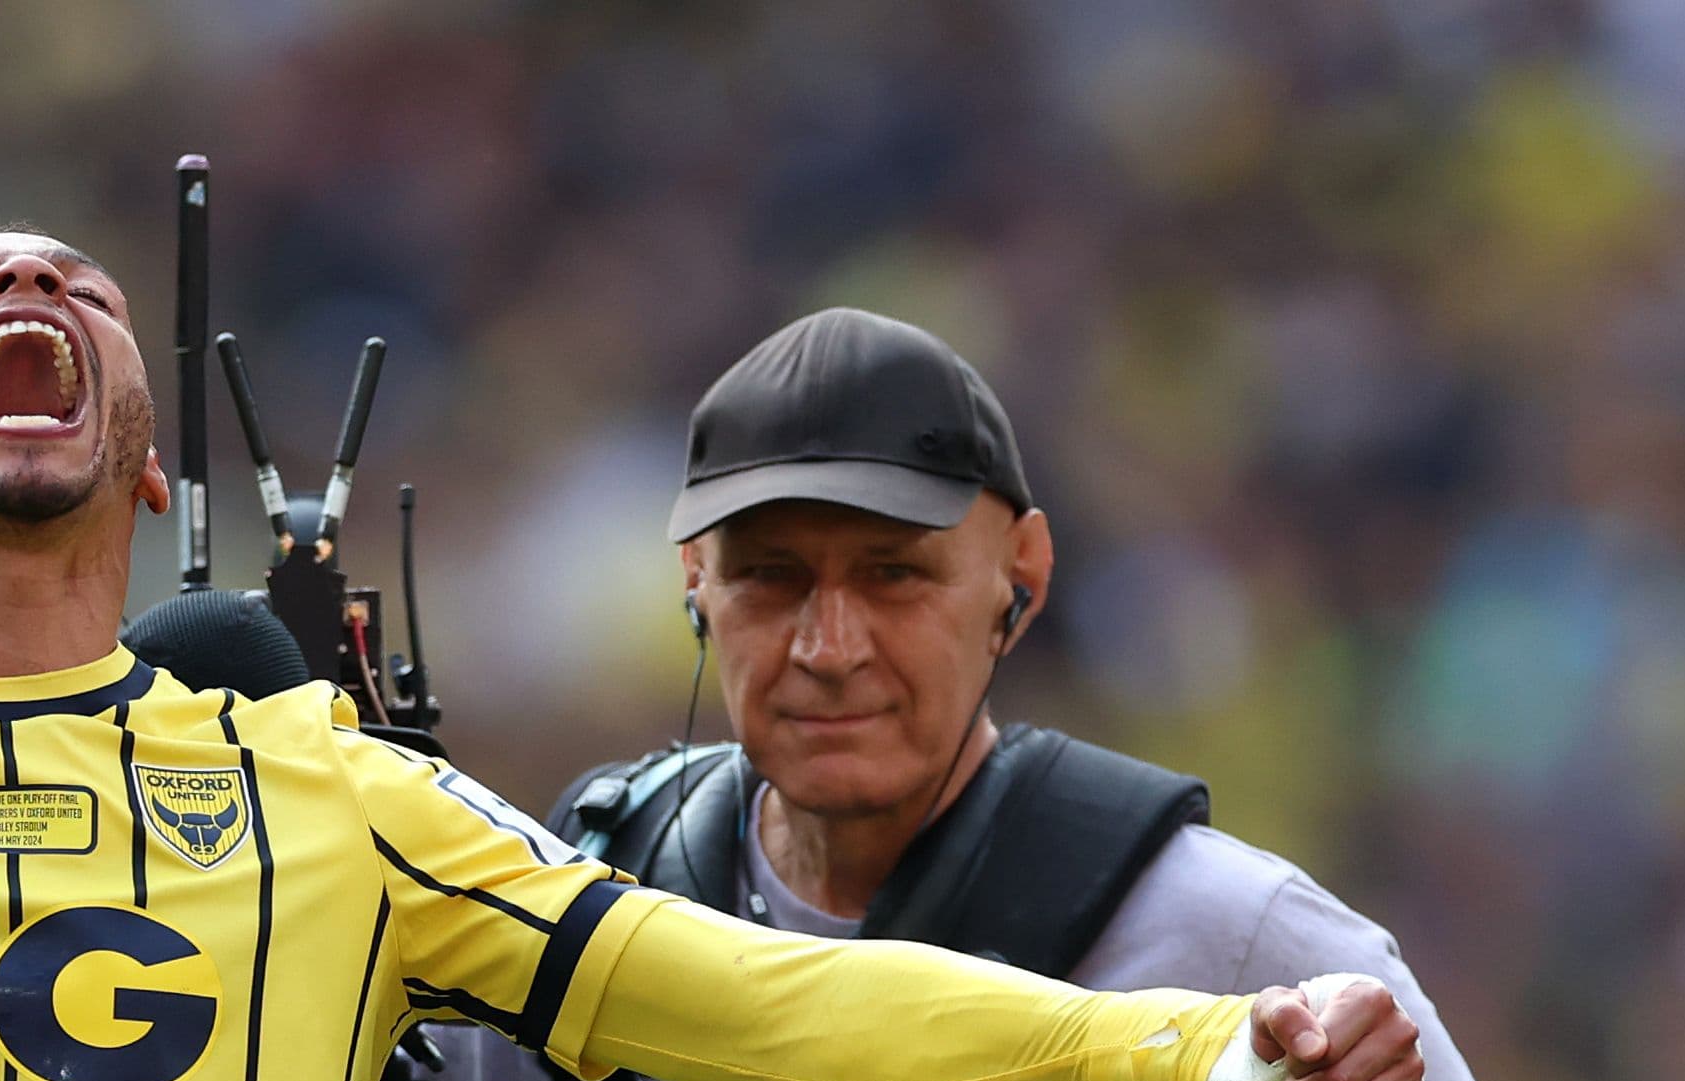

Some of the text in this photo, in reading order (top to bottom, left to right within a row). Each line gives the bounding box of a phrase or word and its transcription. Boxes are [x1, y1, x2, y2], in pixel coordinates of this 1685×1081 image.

[146, 774, 232, 791] OXFORD
[7, 795, 21, 805] ONE
[24, 794, 57, 805] PLAY-OFF
[59, 794, 79, 805] FINAL
[167, 791, 216, 801] UNITED
[20, 808, 25, 818] V
[26, 808, 55, 819] OXFORD
[57, 808, 82, 818] UNITED
[15, 821, 48, 832] STADIUM
[6, 836, 20, 845] MAY
[23, 835, 42, 845] 2024
